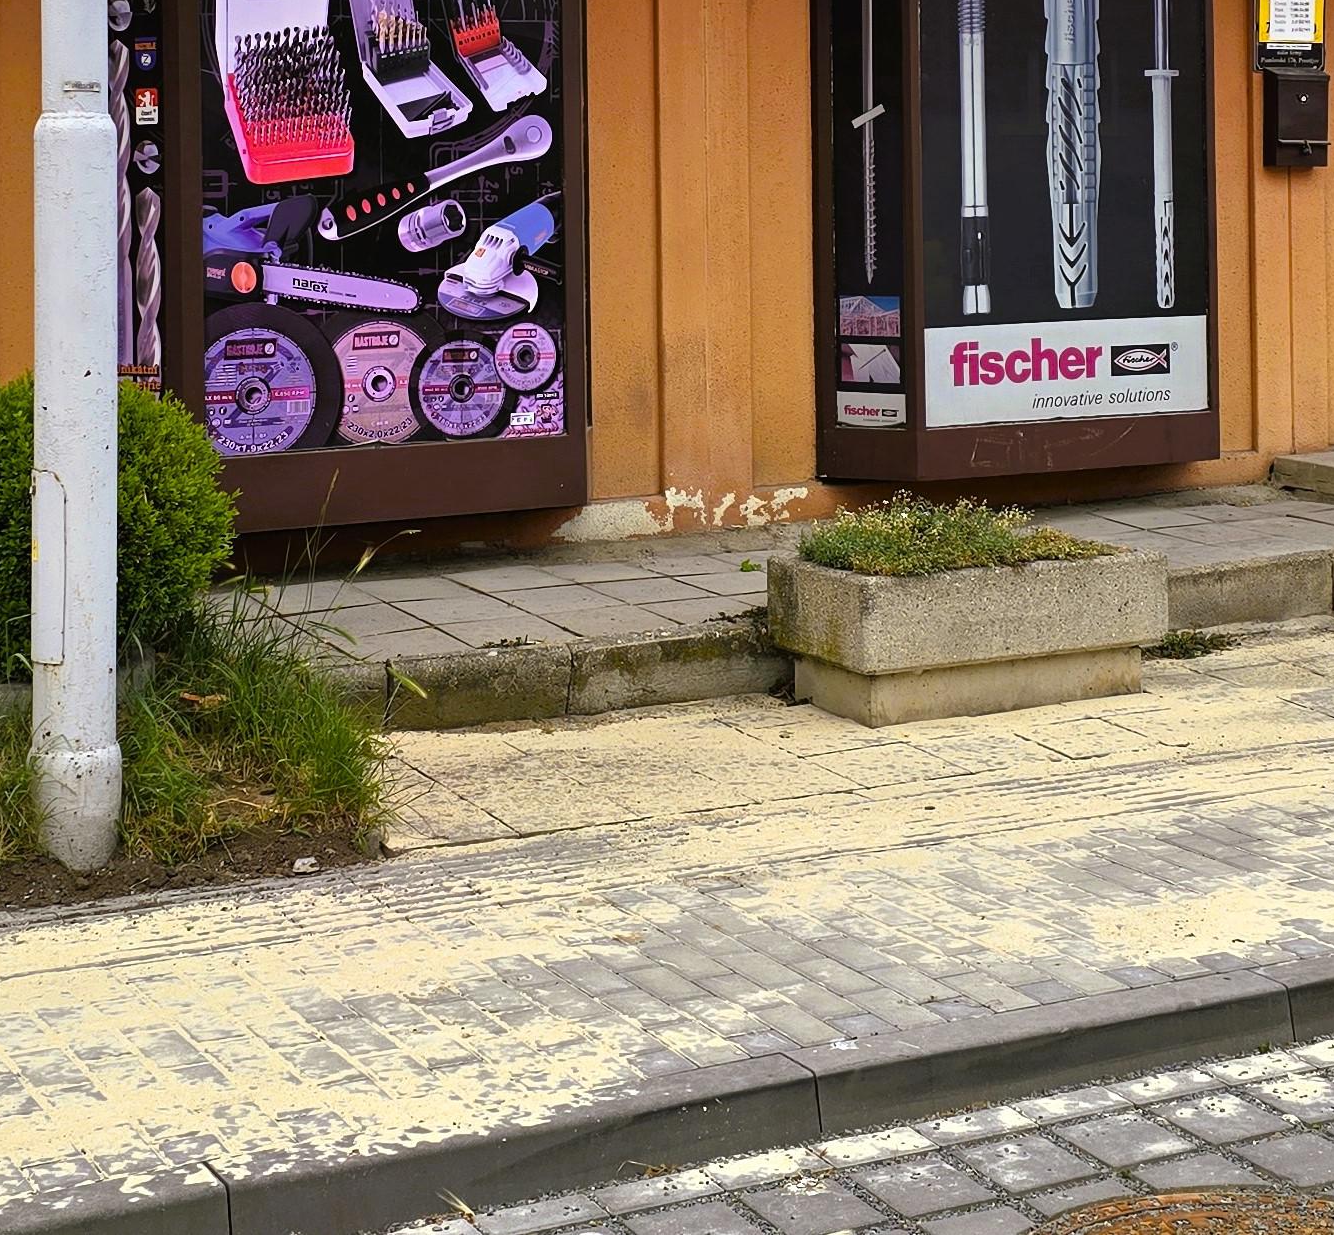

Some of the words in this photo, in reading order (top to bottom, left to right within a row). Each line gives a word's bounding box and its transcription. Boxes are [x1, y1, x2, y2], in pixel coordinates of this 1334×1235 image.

[292, 277, 328, 294] narex
[950, 337, 1103, 387] fischer
[1032, 391, 1103, 409] innovative
[1108, 386, 1171, 404] solutions
[844, 404, 880, 417] fischer
